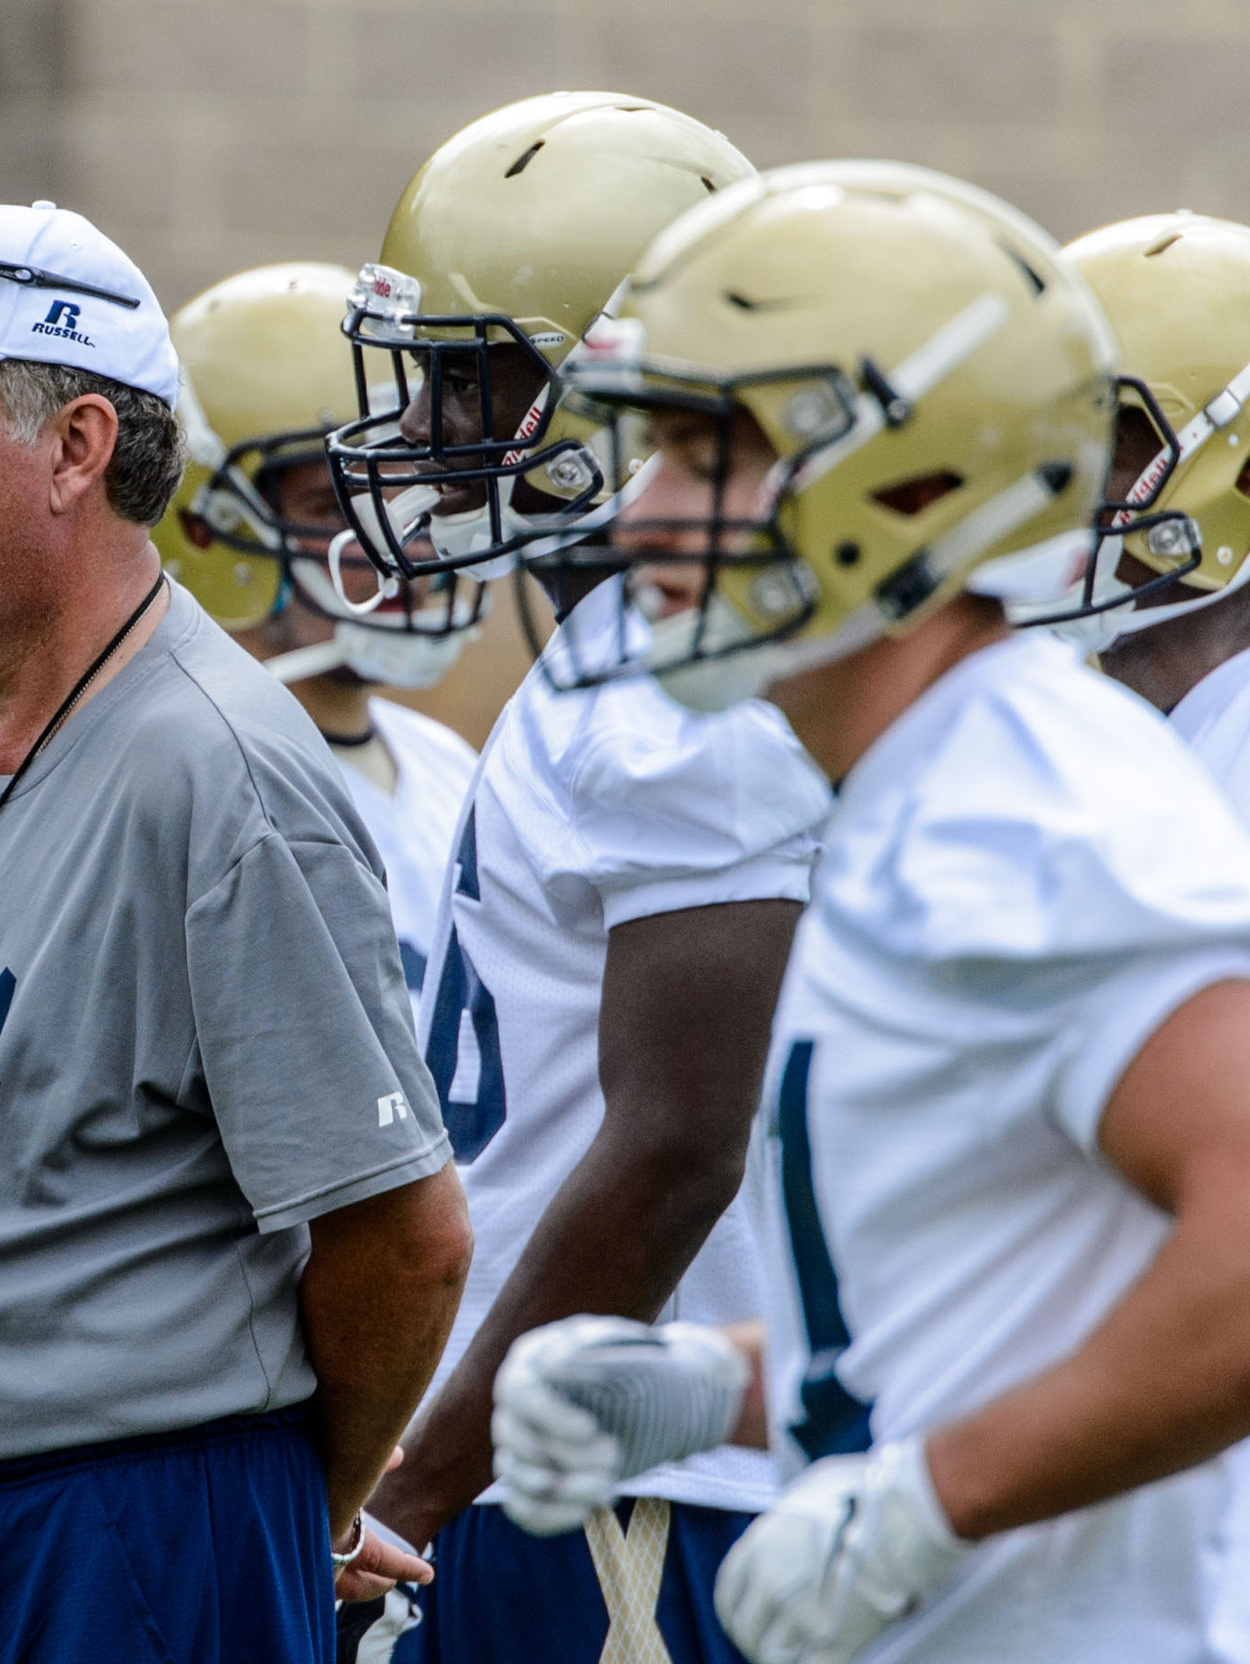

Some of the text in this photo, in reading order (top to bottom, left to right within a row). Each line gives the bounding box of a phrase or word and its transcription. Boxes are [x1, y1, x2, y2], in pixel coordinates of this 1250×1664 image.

[44, 299, 81, 330] R
[31, 322, 91, 347] RUSSELL
[377, 1091, 407, 1127] R
